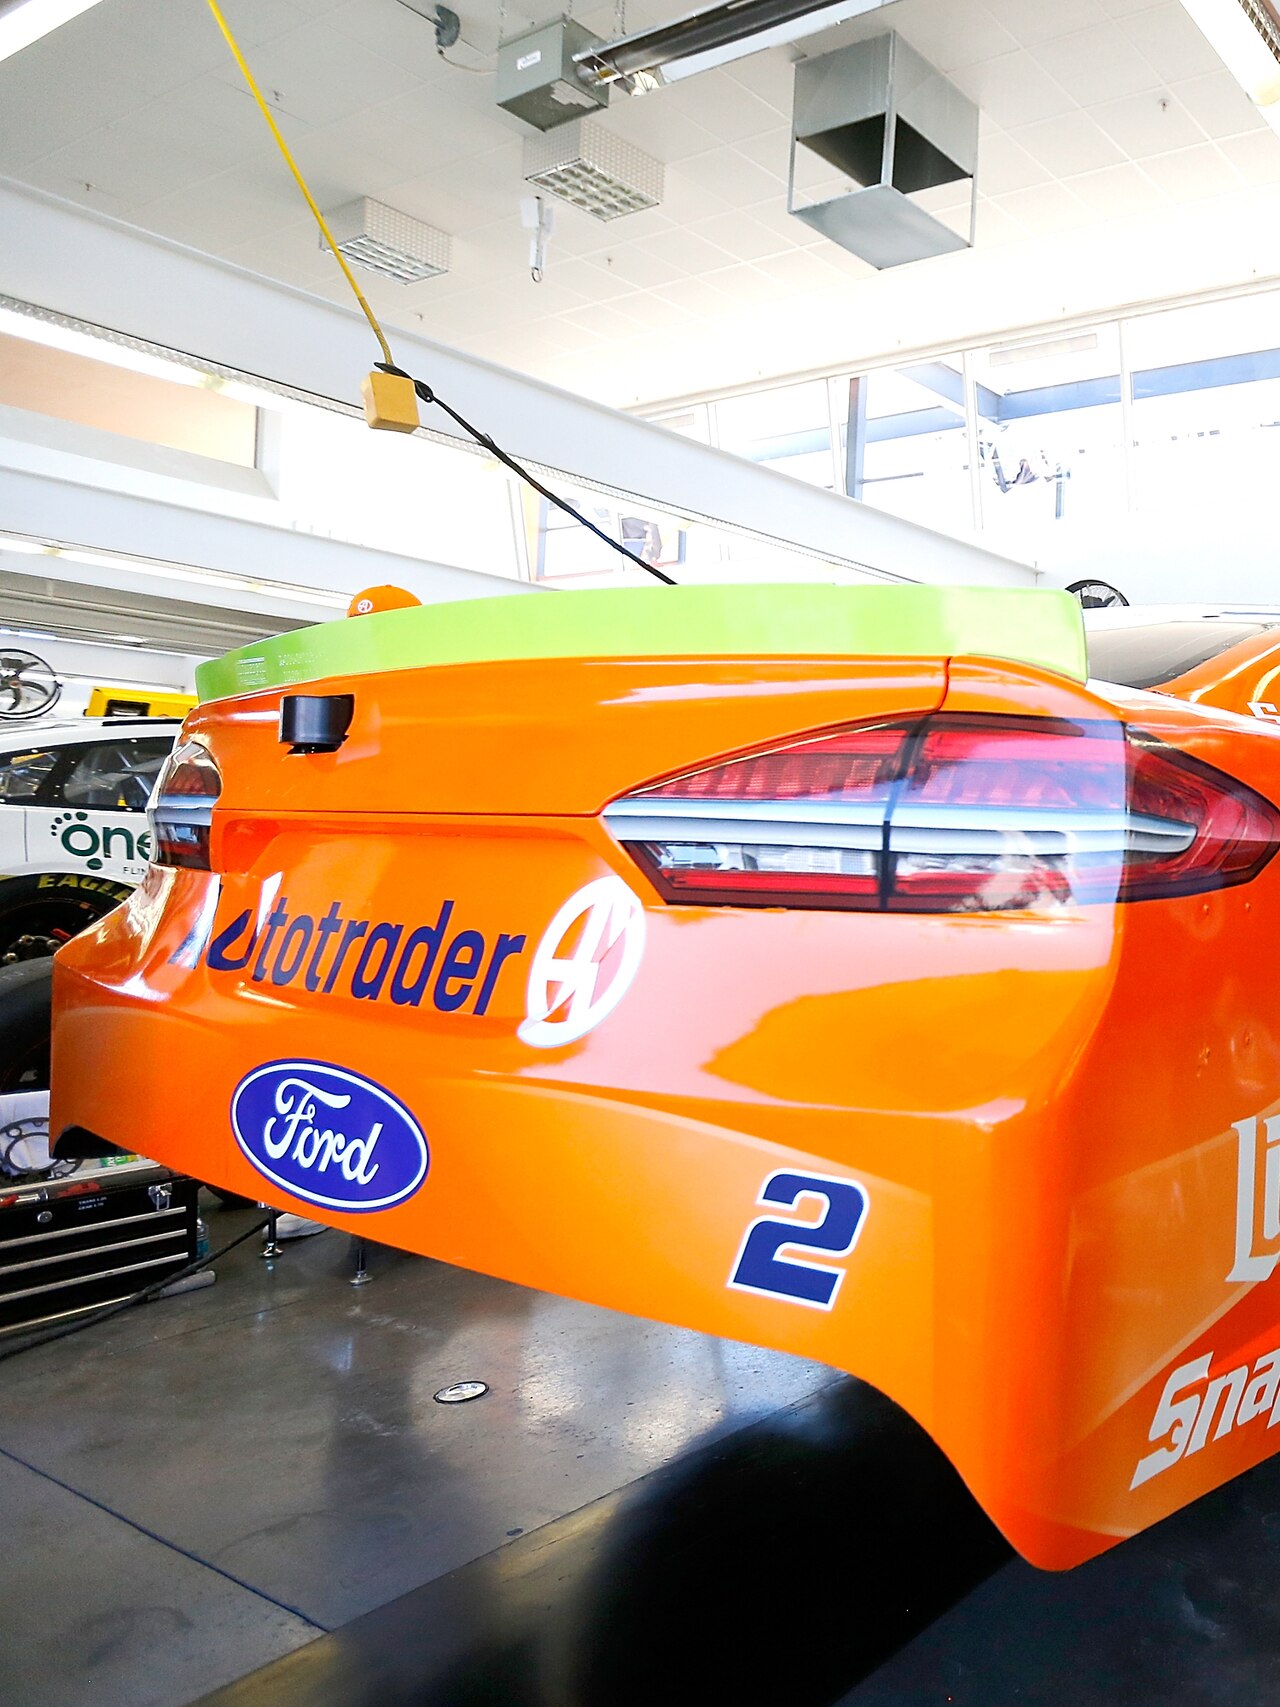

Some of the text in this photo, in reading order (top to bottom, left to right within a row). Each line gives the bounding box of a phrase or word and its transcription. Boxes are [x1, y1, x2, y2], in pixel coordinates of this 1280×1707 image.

[172, 885, 527, 1016] utotrader
[263, 1077, 384, 1185] Ford
[726, 1167, 870, 1312] 2
